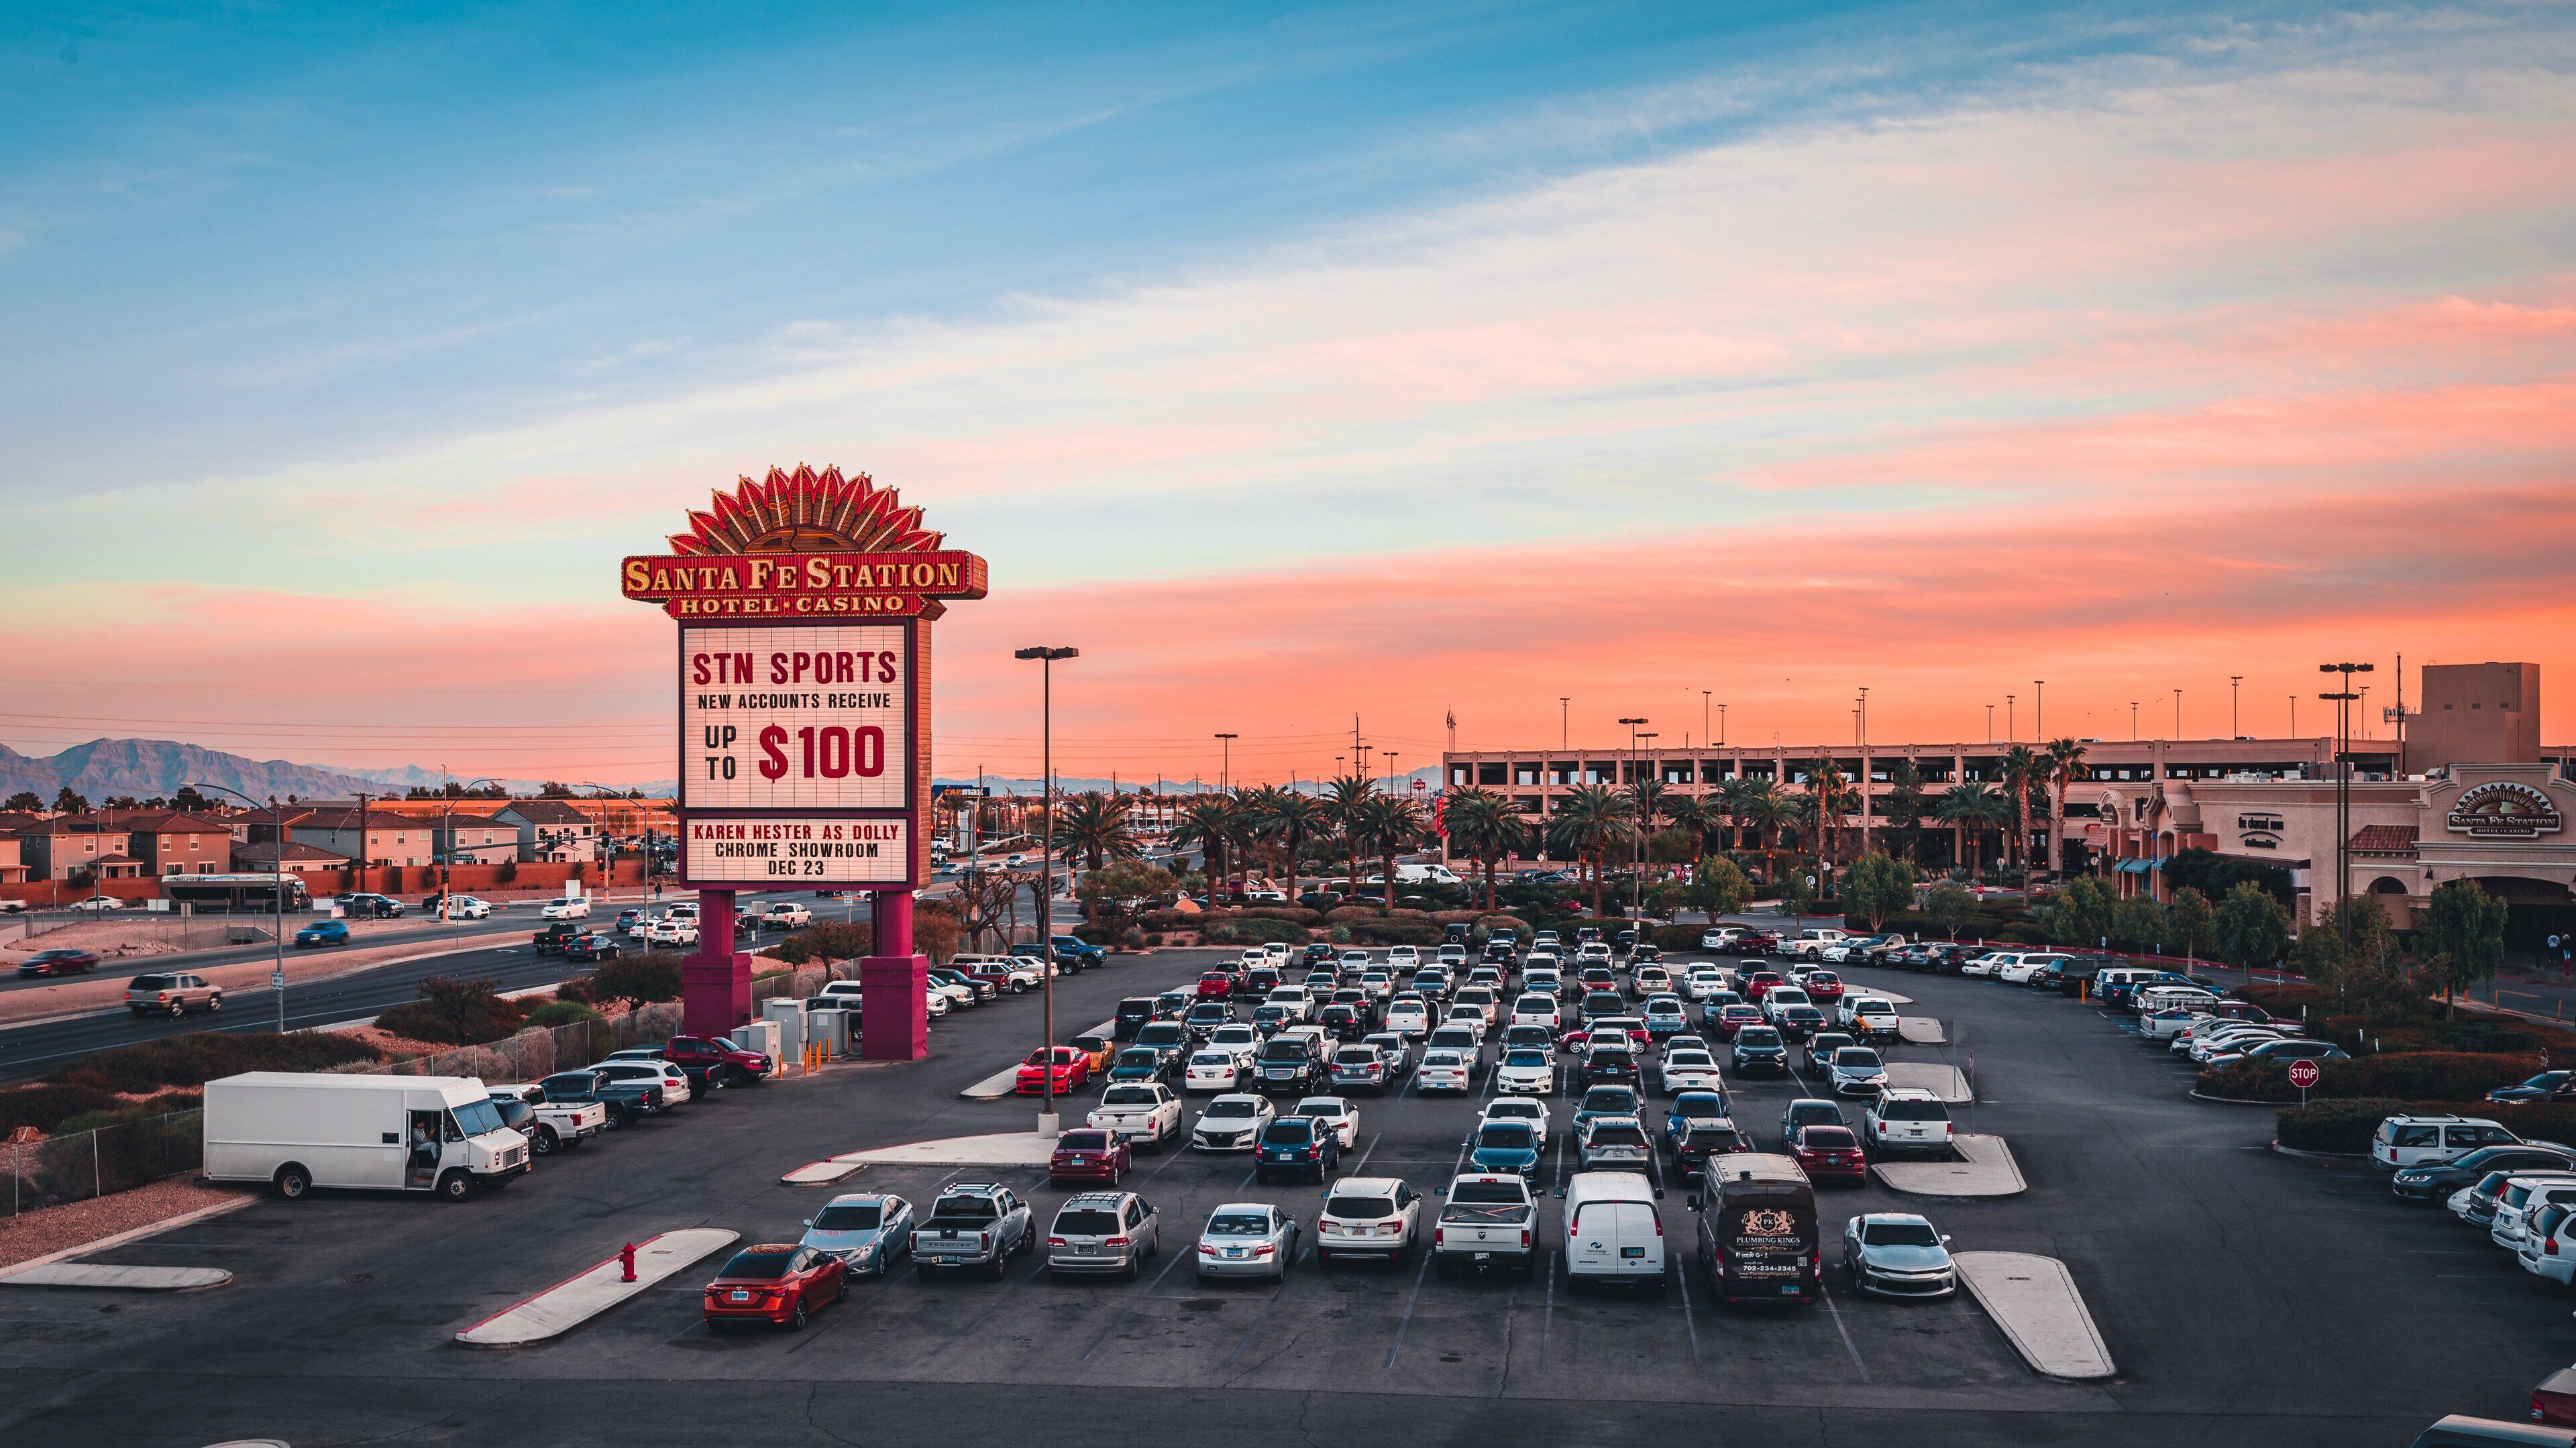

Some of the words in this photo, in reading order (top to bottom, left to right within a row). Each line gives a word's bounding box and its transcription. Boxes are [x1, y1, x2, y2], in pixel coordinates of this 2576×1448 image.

[627, 561, 739, 592] SANTA
[748, 559, 797, 590] FE
[806, 557, 960, 588] STATION
[680, 598, 779, 613] HOTEL
[796, 596, 904, 612] CASINO
[693, 653, 753, 685] STN
[771, 651, 896, 684] SPORTS
[698, 693, 731, 709] NEW
[738, 693, 820, 709] ACCOUNTS
[828, 693, 891, 708] RECEIVE
[705, 725, 737, 748] UP
[759, 722, 884, 784] $100
[705, 756, 736, 780] TO
[2451, 816, 2486, 826] SANTA
[2489, 816, 2504, 826] FE
[2507, 816, 2556, 826] STATION
[694, 824, 745, 840] KAREN
[753, 824, 811, 840] HESTER
[822, 825, 843, 840] AS
[853, 825, 899, 840] DOLLY
[715, 842, 777, 857] CHROME
[789, 842, 878, 858] SHOWROOM
[768, 860, 796, 875] DEC
[804, 860, 824, 875] 23
[2292, 1068, 2316, 1078] STOP
